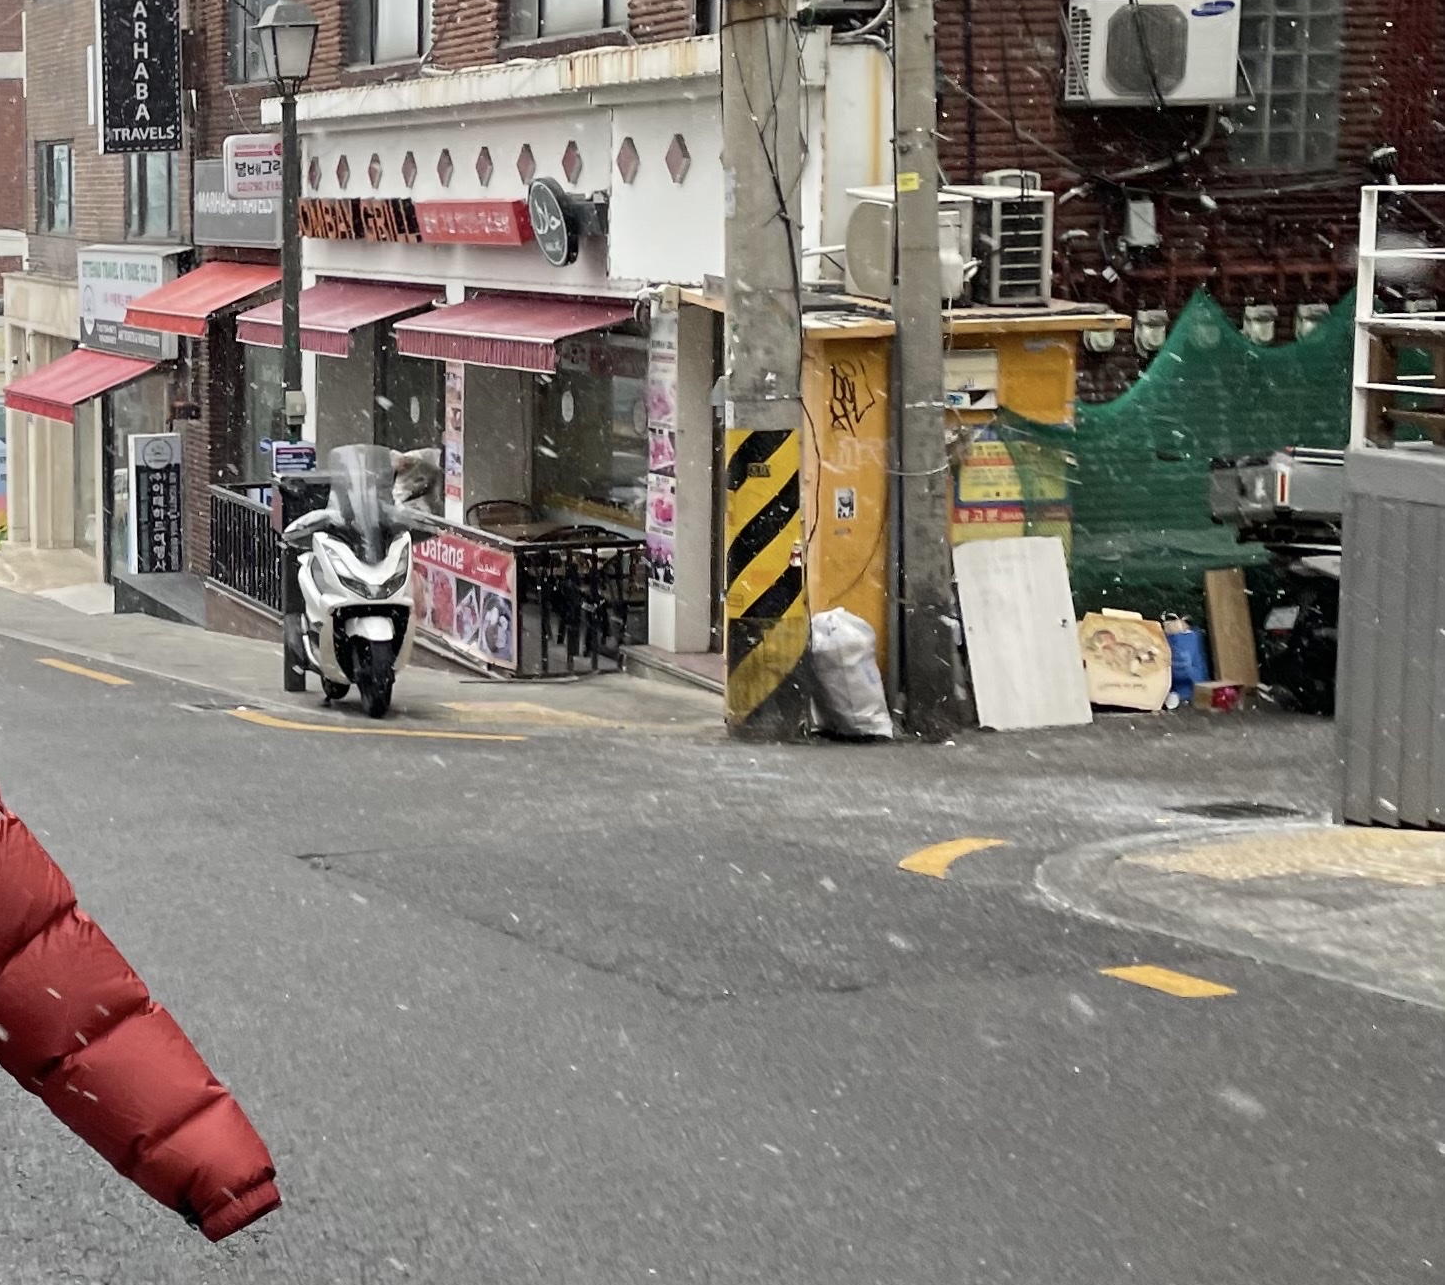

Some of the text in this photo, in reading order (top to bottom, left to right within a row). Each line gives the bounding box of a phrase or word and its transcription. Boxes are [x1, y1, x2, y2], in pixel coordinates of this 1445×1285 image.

[111, 125, 176, 142] TRAVELS
[299, 198, 359, 239] OMBAY
[360, 198, 422, 243] GRILL
